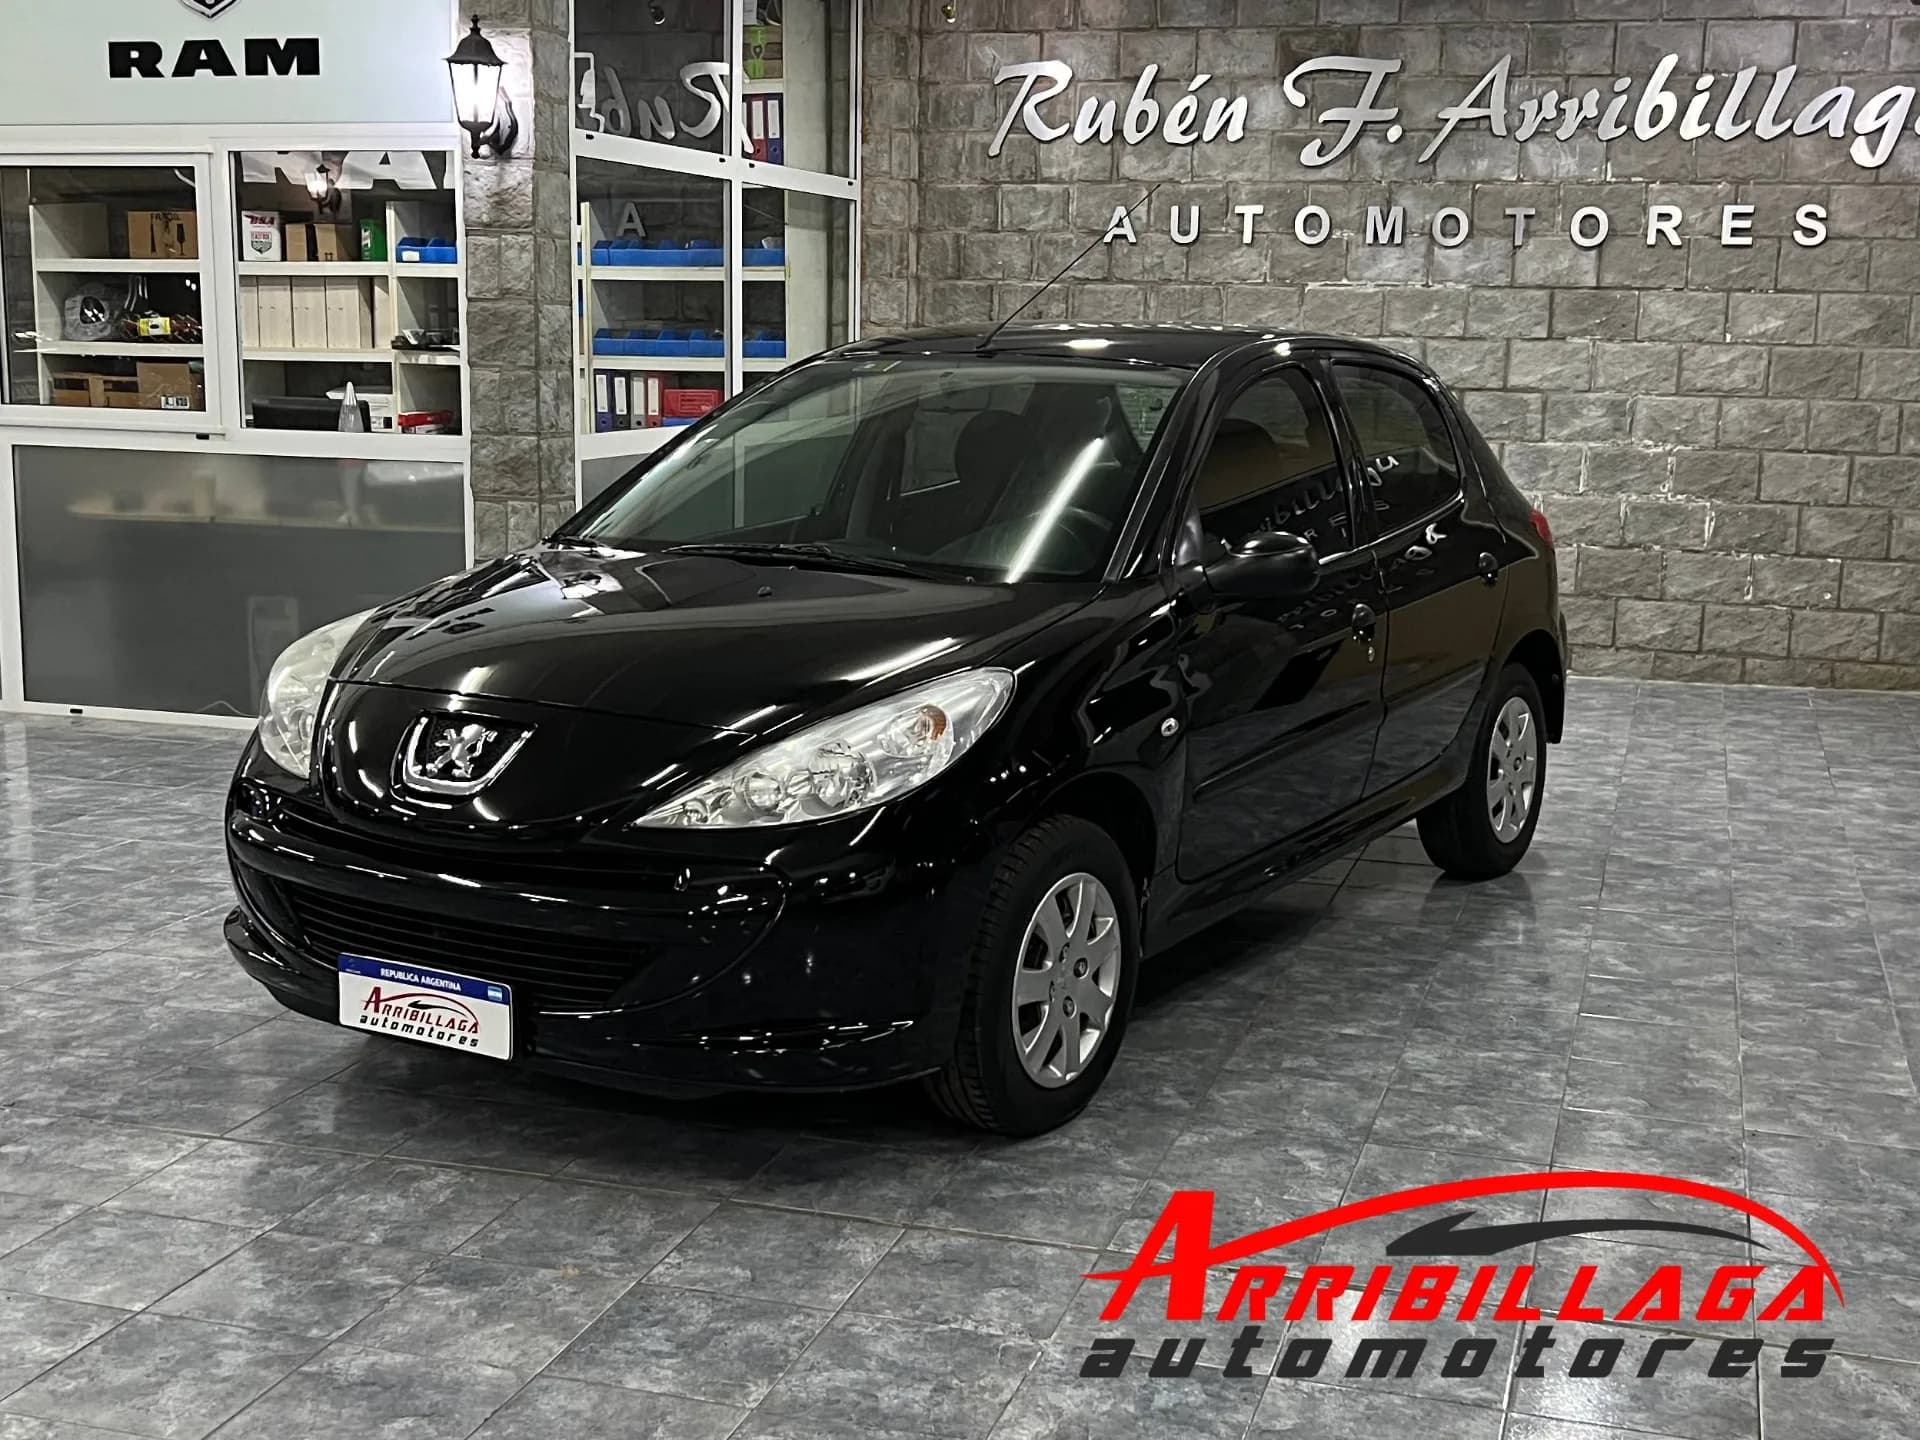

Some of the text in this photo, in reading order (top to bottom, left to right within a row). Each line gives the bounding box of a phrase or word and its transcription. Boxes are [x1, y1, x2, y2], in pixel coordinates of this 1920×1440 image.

[108, 38, 320, 79] RAM
[988, 53, 1920, 168] Rubén F. Arribillag
[1103, 204, 1828, 248] AUTOMOTORES
[420, 975, 461, 991] ARGENTINA
[359, 1014, 479, 1048] automotores
[361, 986, 479, 1034] ARRIBILLAGA
